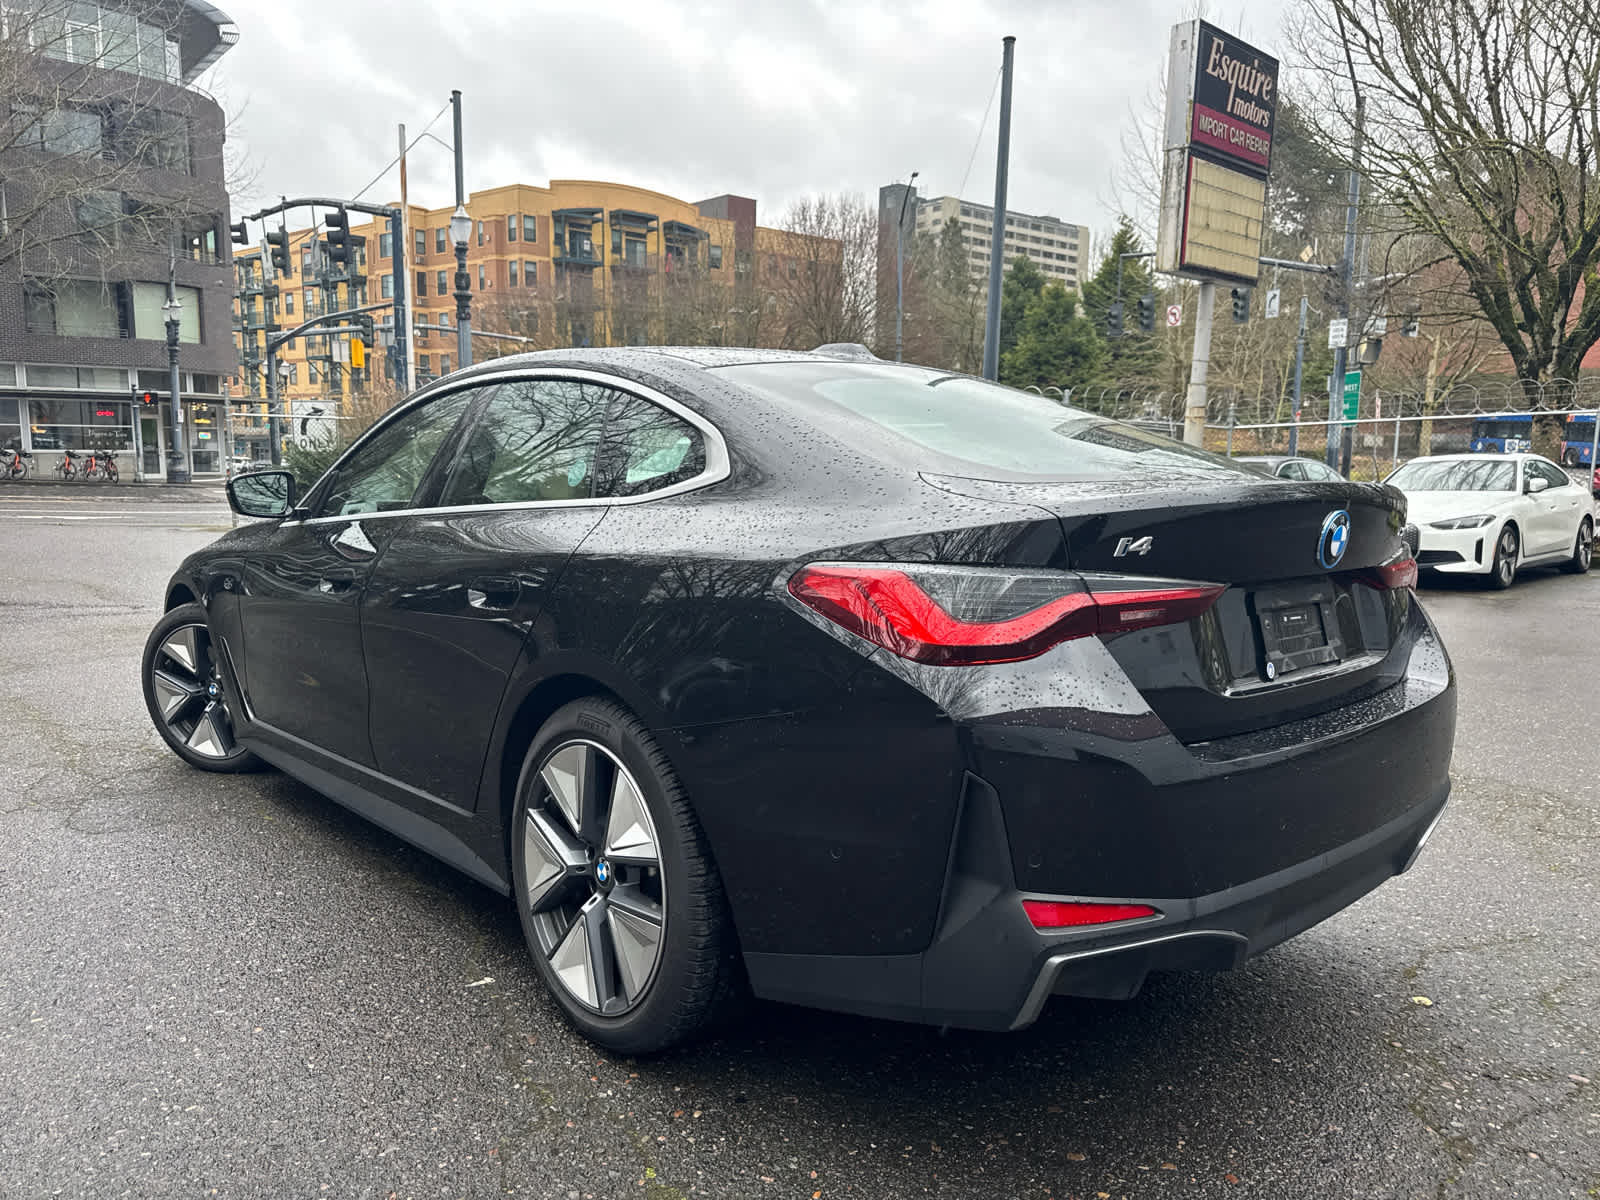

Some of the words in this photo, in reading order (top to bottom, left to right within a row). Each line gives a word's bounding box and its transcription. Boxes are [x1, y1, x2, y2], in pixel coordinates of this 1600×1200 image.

[1206, 37, 1273, 113] Esquire
[1233, 97, 1270, 127] motors
[1199, 114, 1229, 140] IMPORT
[1229, 127, 1246, 149] CAR
[1246, 132, 1271, 157] REPAIR
[1113, 536, 1153, 557] i4
